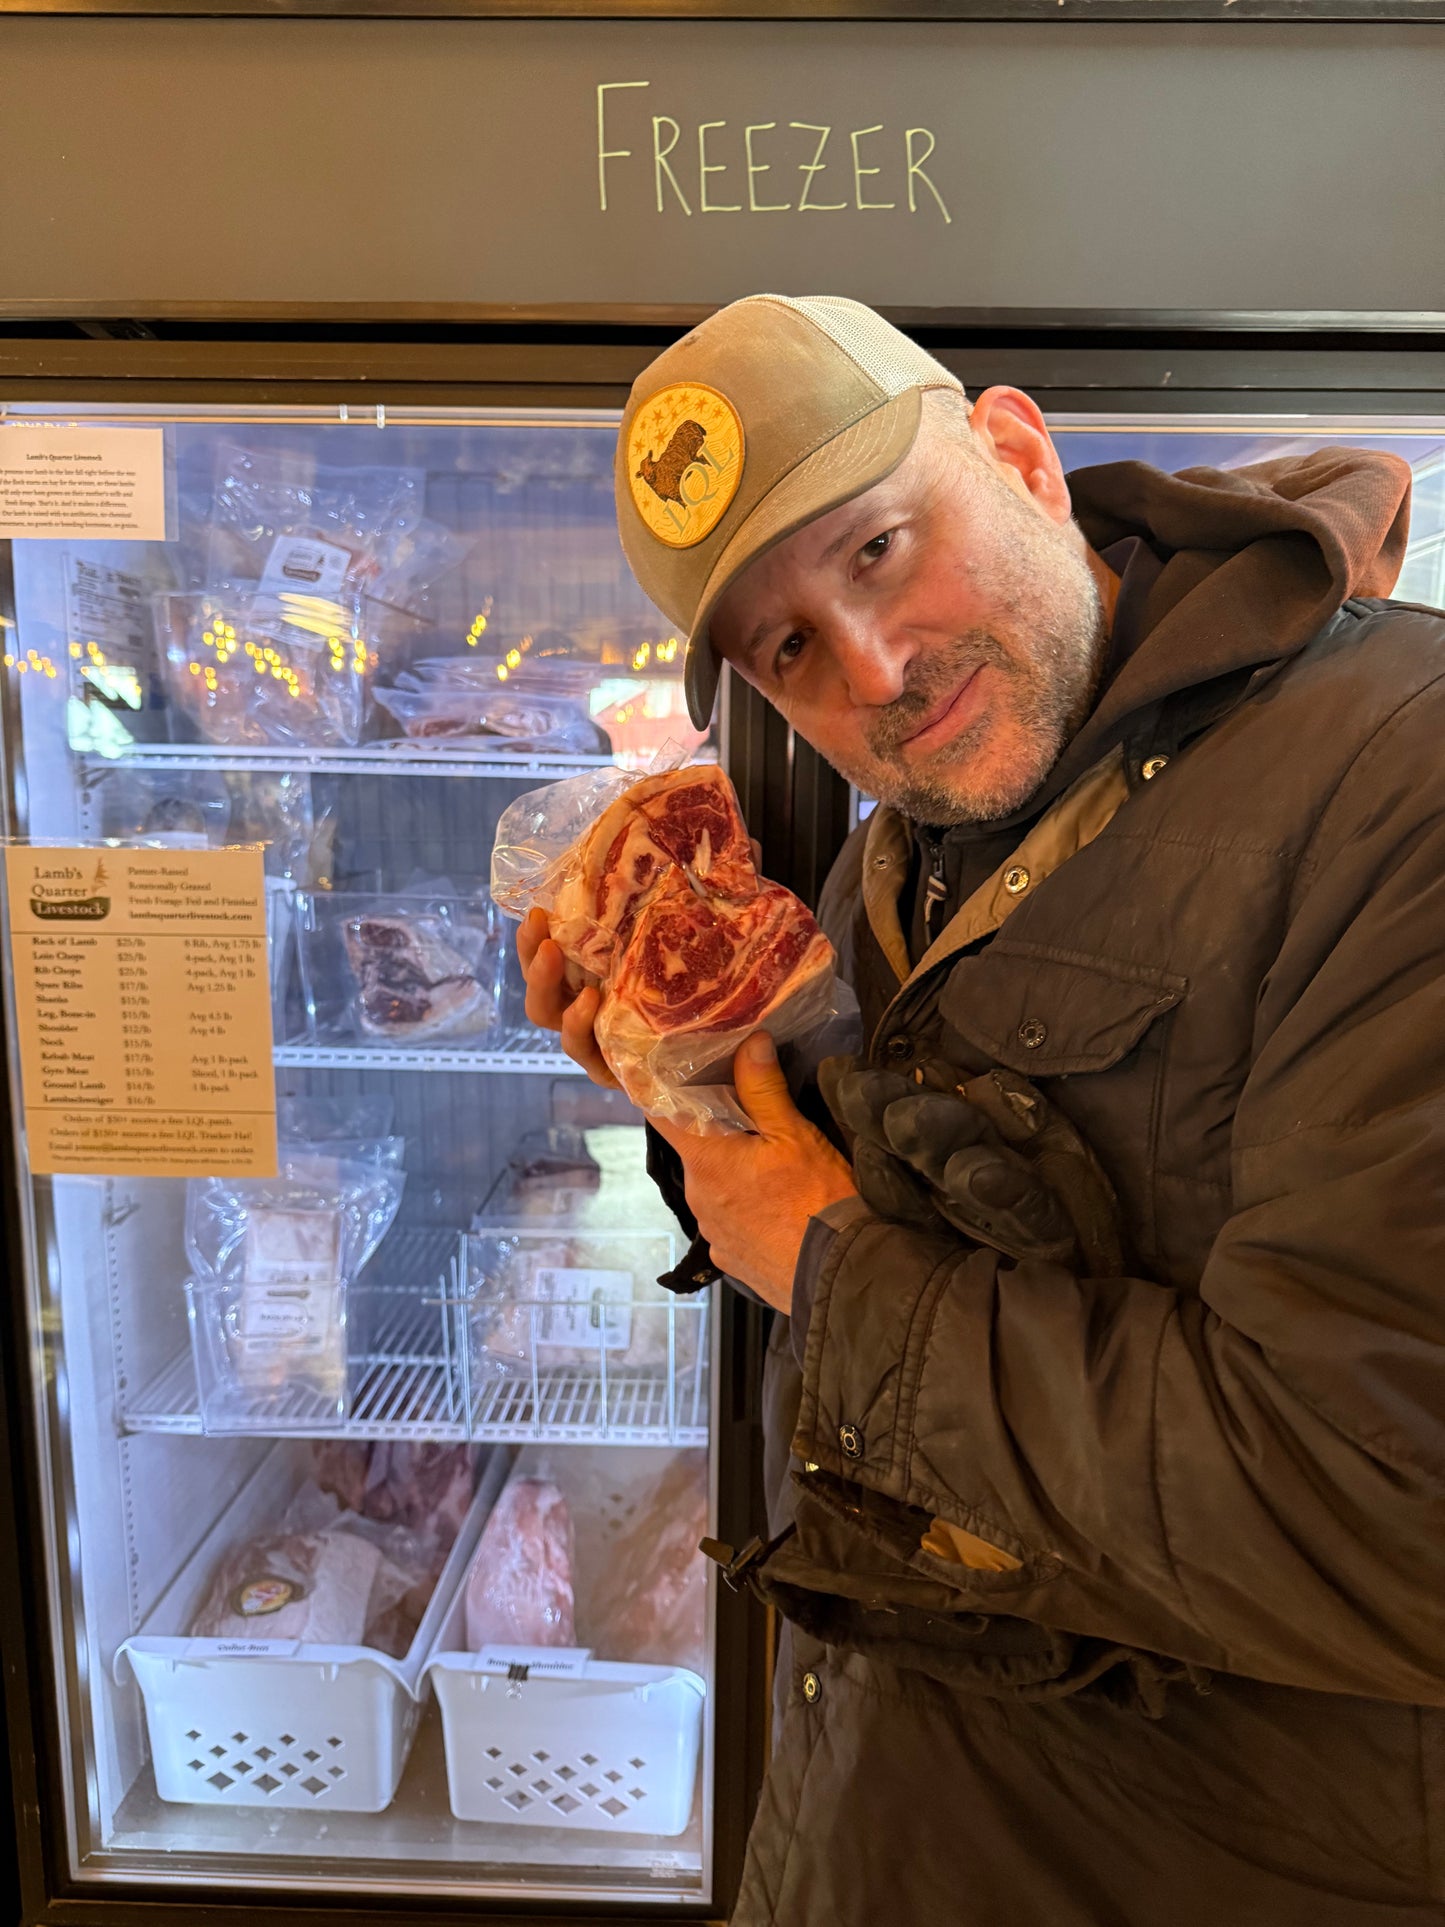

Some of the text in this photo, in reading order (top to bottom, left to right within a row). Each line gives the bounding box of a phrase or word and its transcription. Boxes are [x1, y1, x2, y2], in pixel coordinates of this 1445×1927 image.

[598, 82, 951, 223] FREEZER
[49, 454, 73, 462] Quarter
[663, 441, 734, 537] LQL
[34, 867, 83, 880] Lamb's
[32, 884, 88, 898] Quarter
[36, 902, 105, 916] Livestock
[129, 911, 252, 922] lambsquarterlivestock.com
